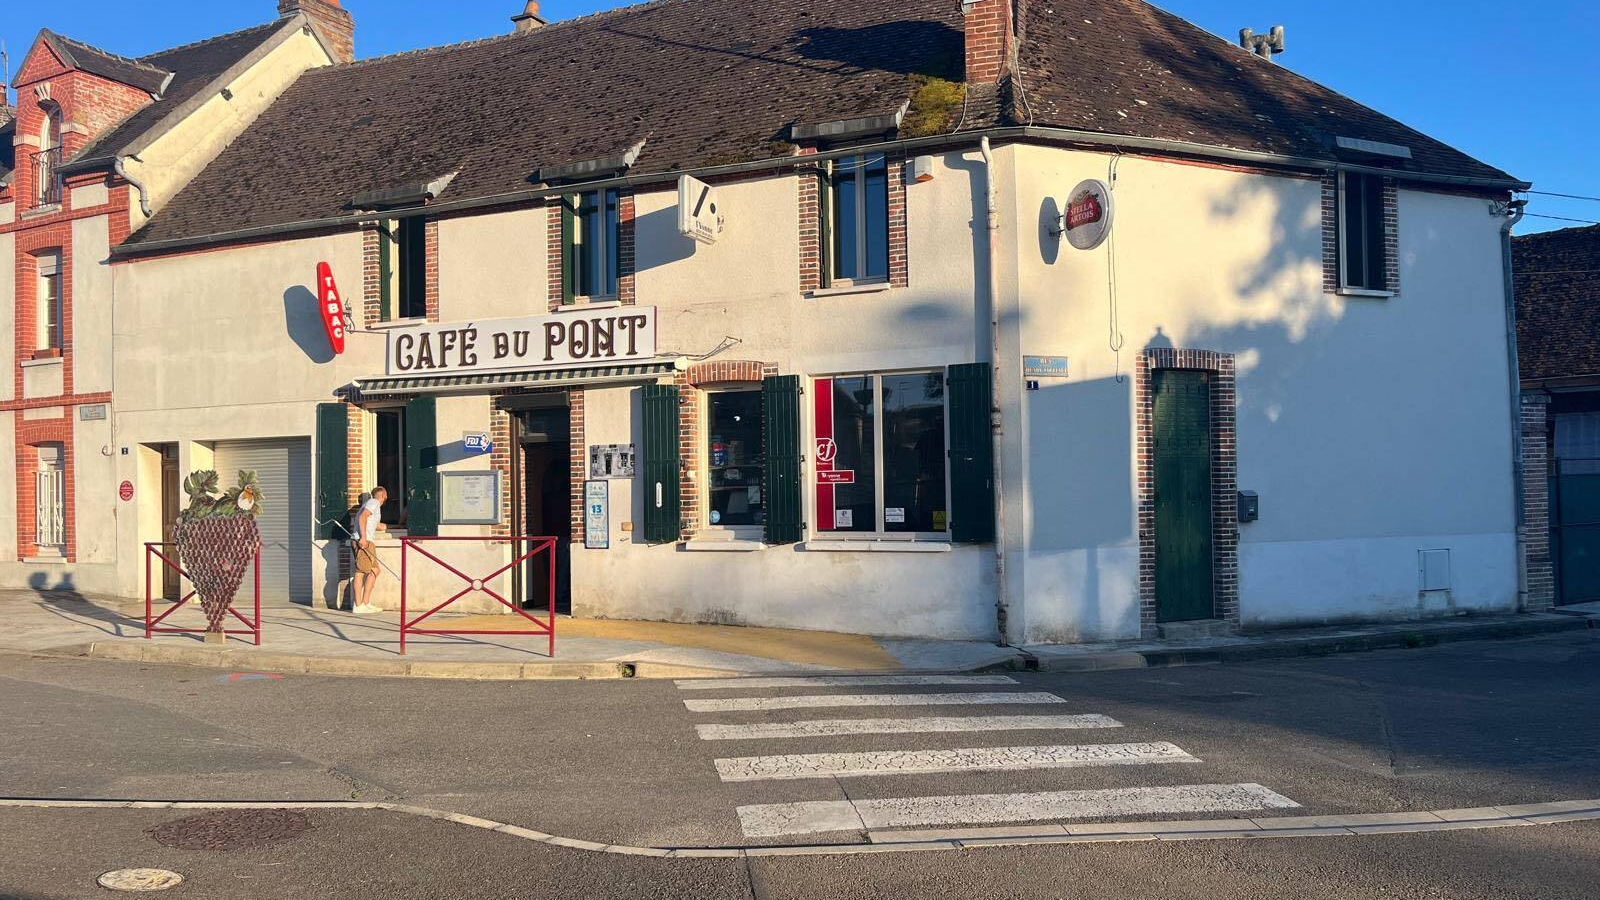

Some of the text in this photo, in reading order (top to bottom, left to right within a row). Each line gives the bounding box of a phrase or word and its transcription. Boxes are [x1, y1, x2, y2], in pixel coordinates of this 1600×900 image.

[1070, 202, 1093, 216] STELLA
[1070, 210, 1094, 224] ARTOIS
[325, 276, 343, 338] TABAC
[395, 314, 647, 371] CAFÉ DU PONT
[467, 437, 479, 446] FDJ
[591, 504, 602, 514] 13
